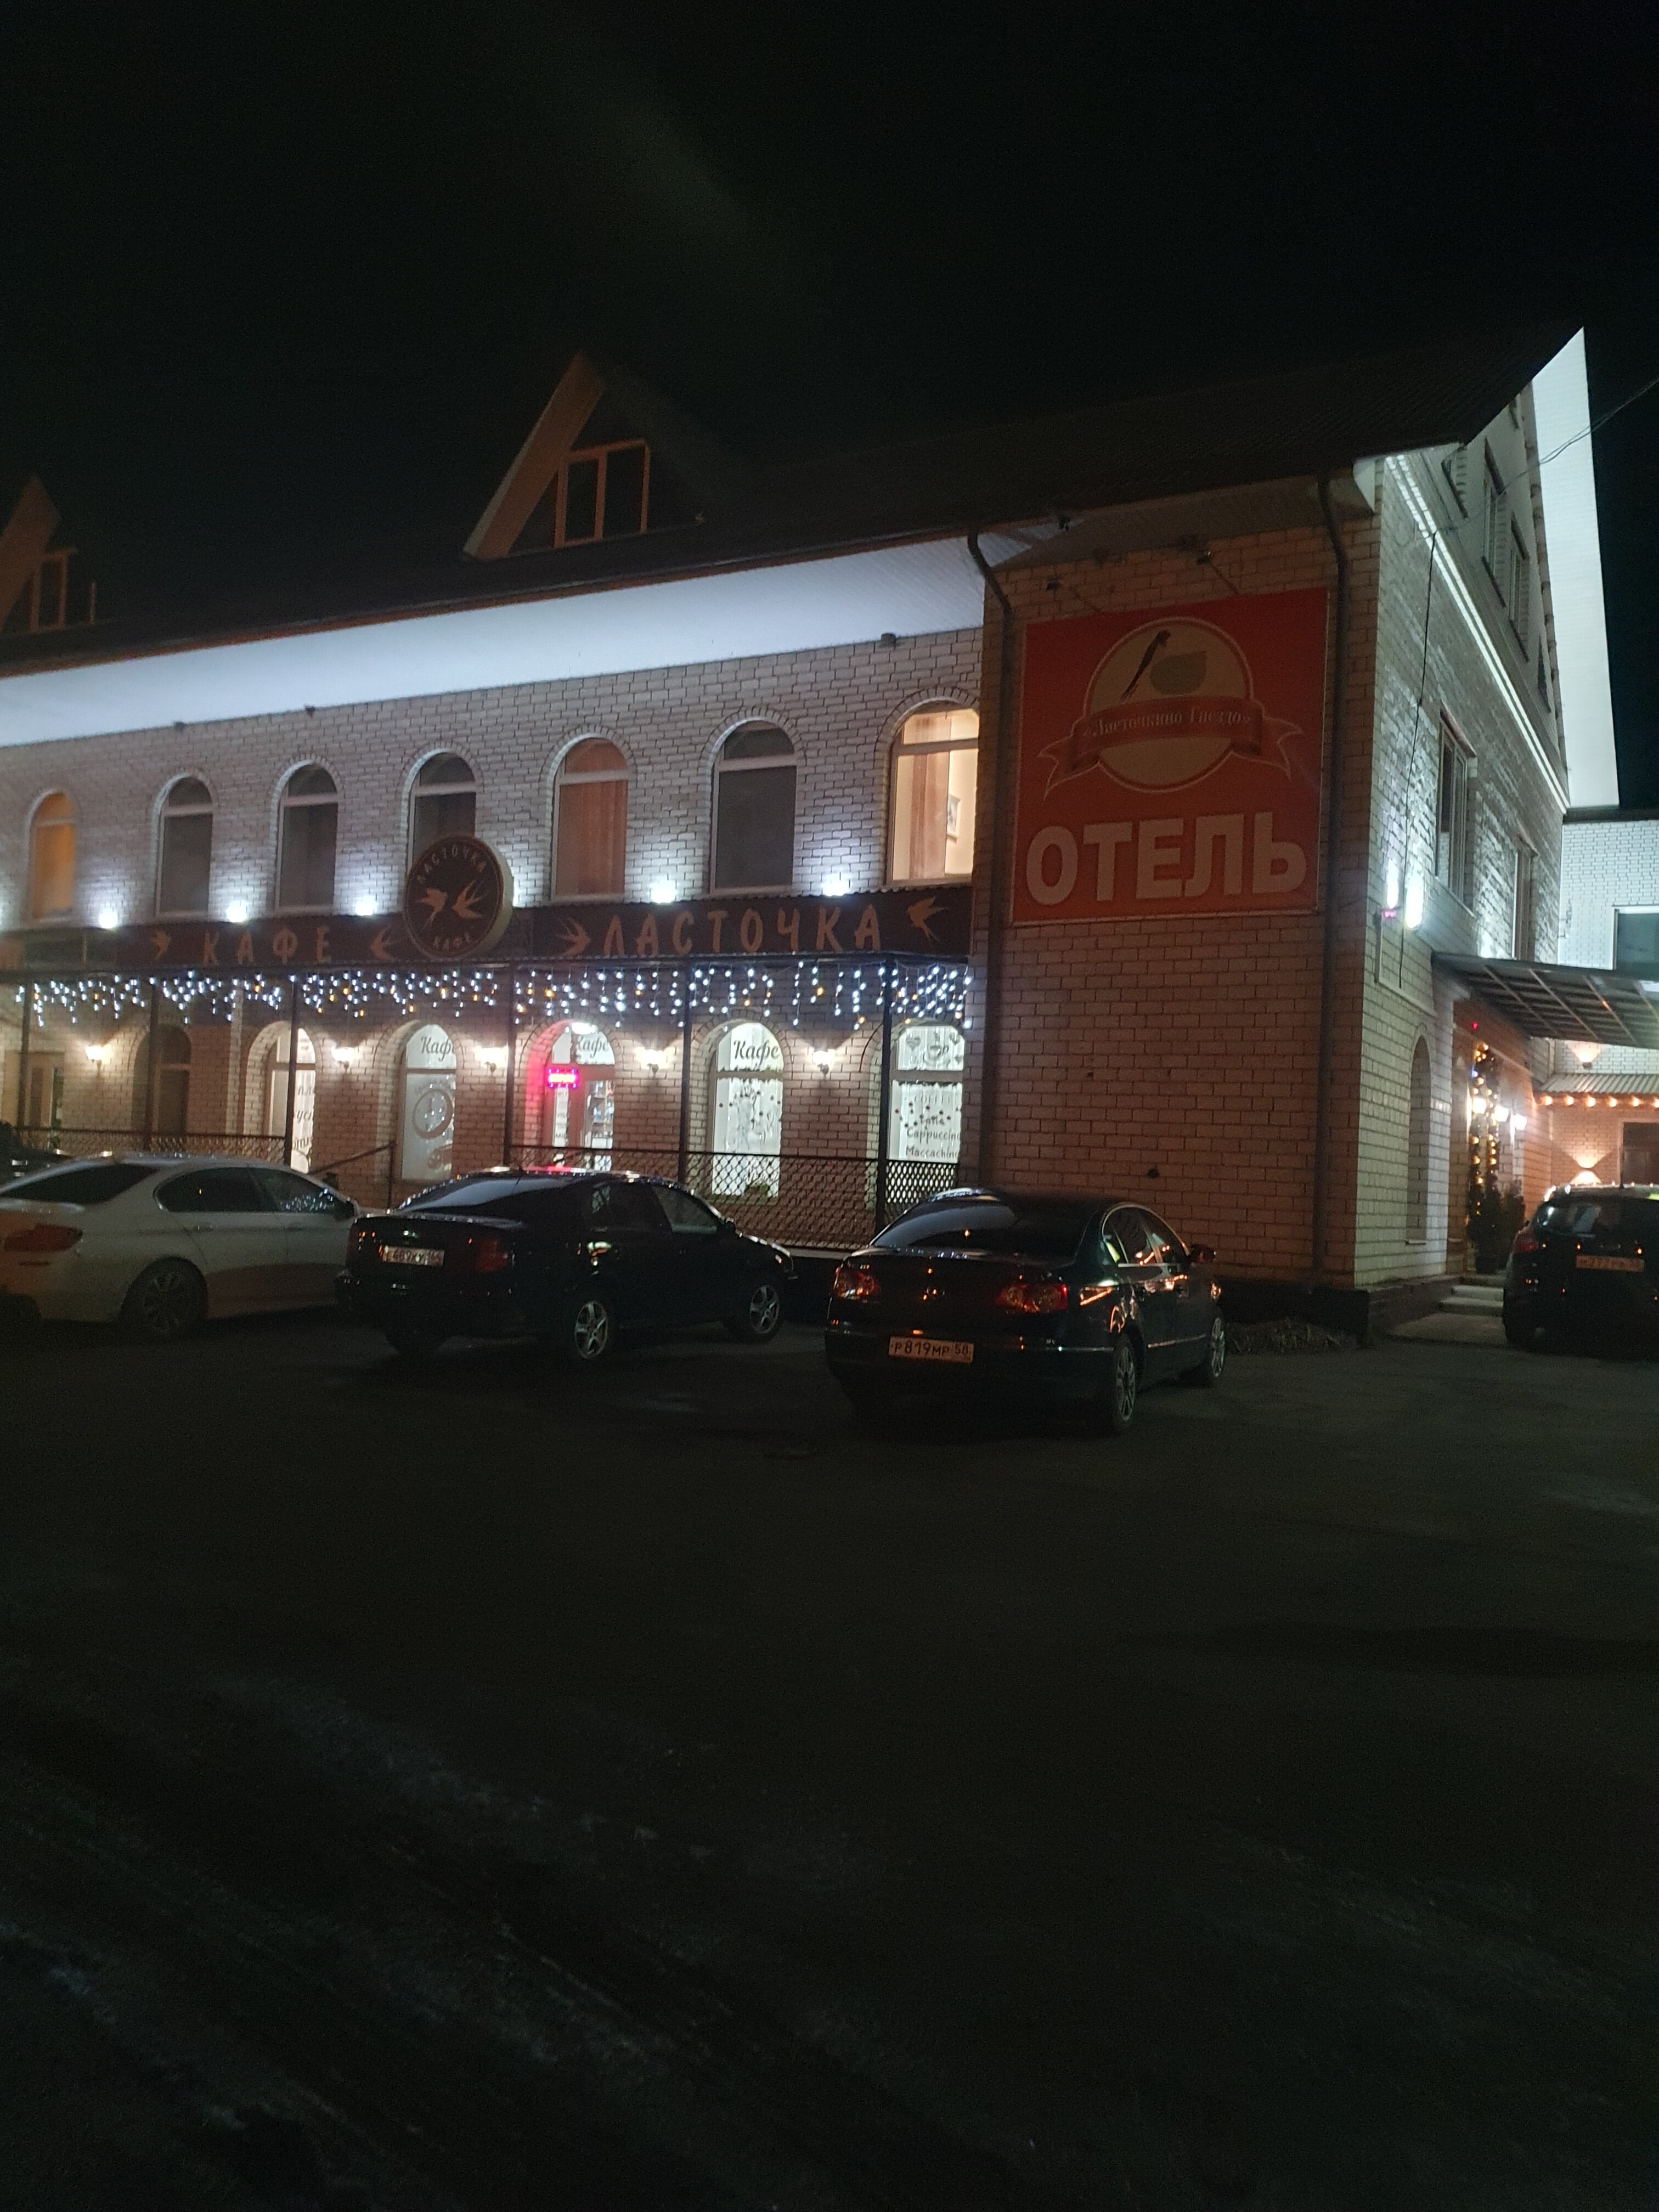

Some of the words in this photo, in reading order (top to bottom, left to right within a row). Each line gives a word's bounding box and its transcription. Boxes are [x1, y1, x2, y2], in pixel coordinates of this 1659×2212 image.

[1026, 811, 1306, 906] ОТЕЛЬ
[201, 925, 332, 966] КАФЕ
[602, 903, 881, 958] ЛАСТОЧКА
[421, 1036, 452, 1062] Каф
[733, 1040, 780, 1066] Кафе
